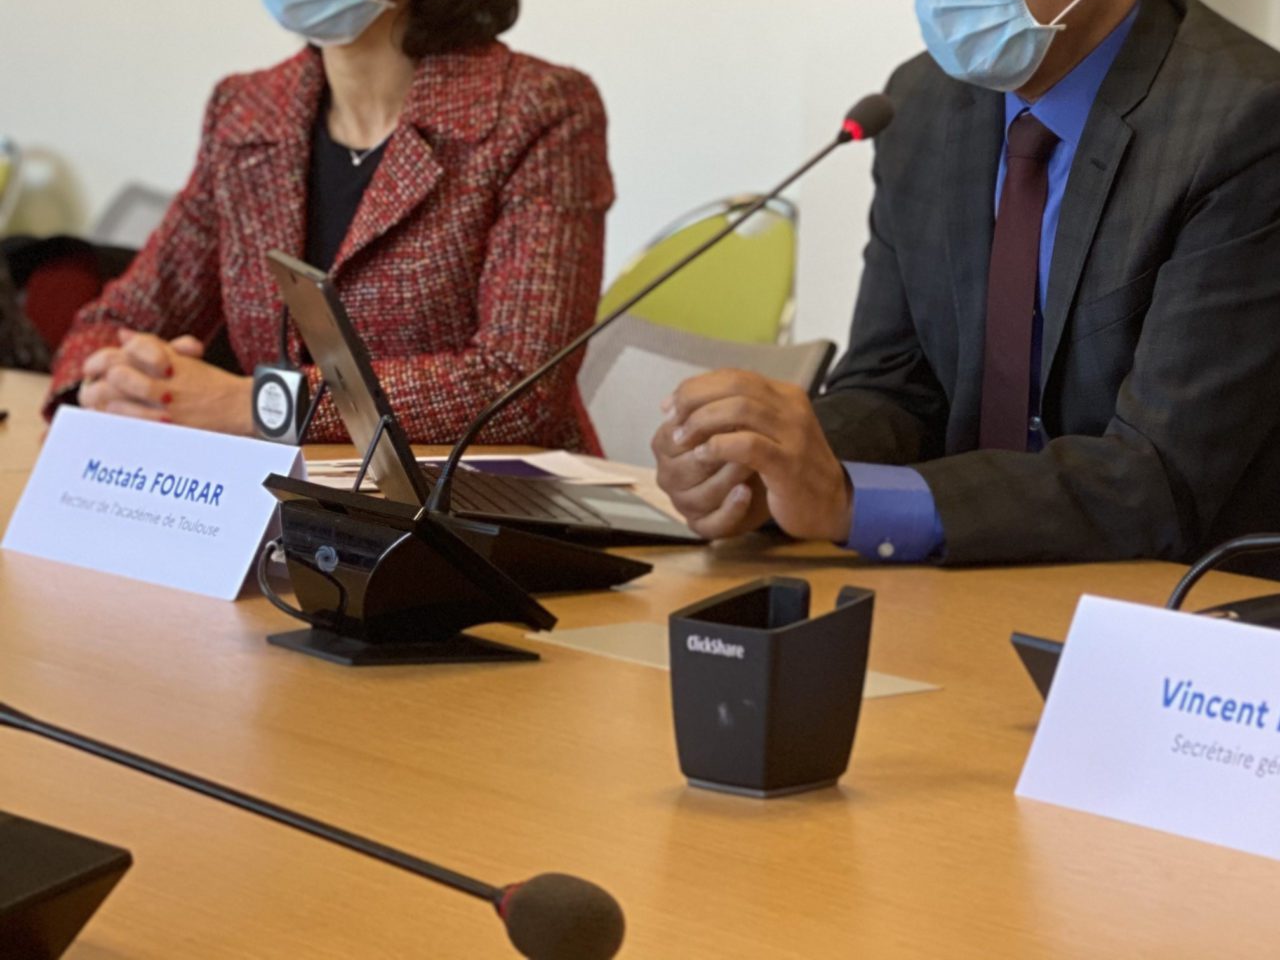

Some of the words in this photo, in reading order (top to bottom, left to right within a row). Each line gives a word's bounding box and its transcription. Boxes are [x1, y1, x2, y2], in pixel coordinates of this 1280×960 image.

[82, 458, 147, 491] Mostafa
[149, 472, 224, 507] FOURAR
[162, 513, 176, 529] de
[178, 515, 220, 537] Toulouse
[1161, 677, 1269, 729] Vincent
[1171, 733, 1254, 770] Secrétaire
